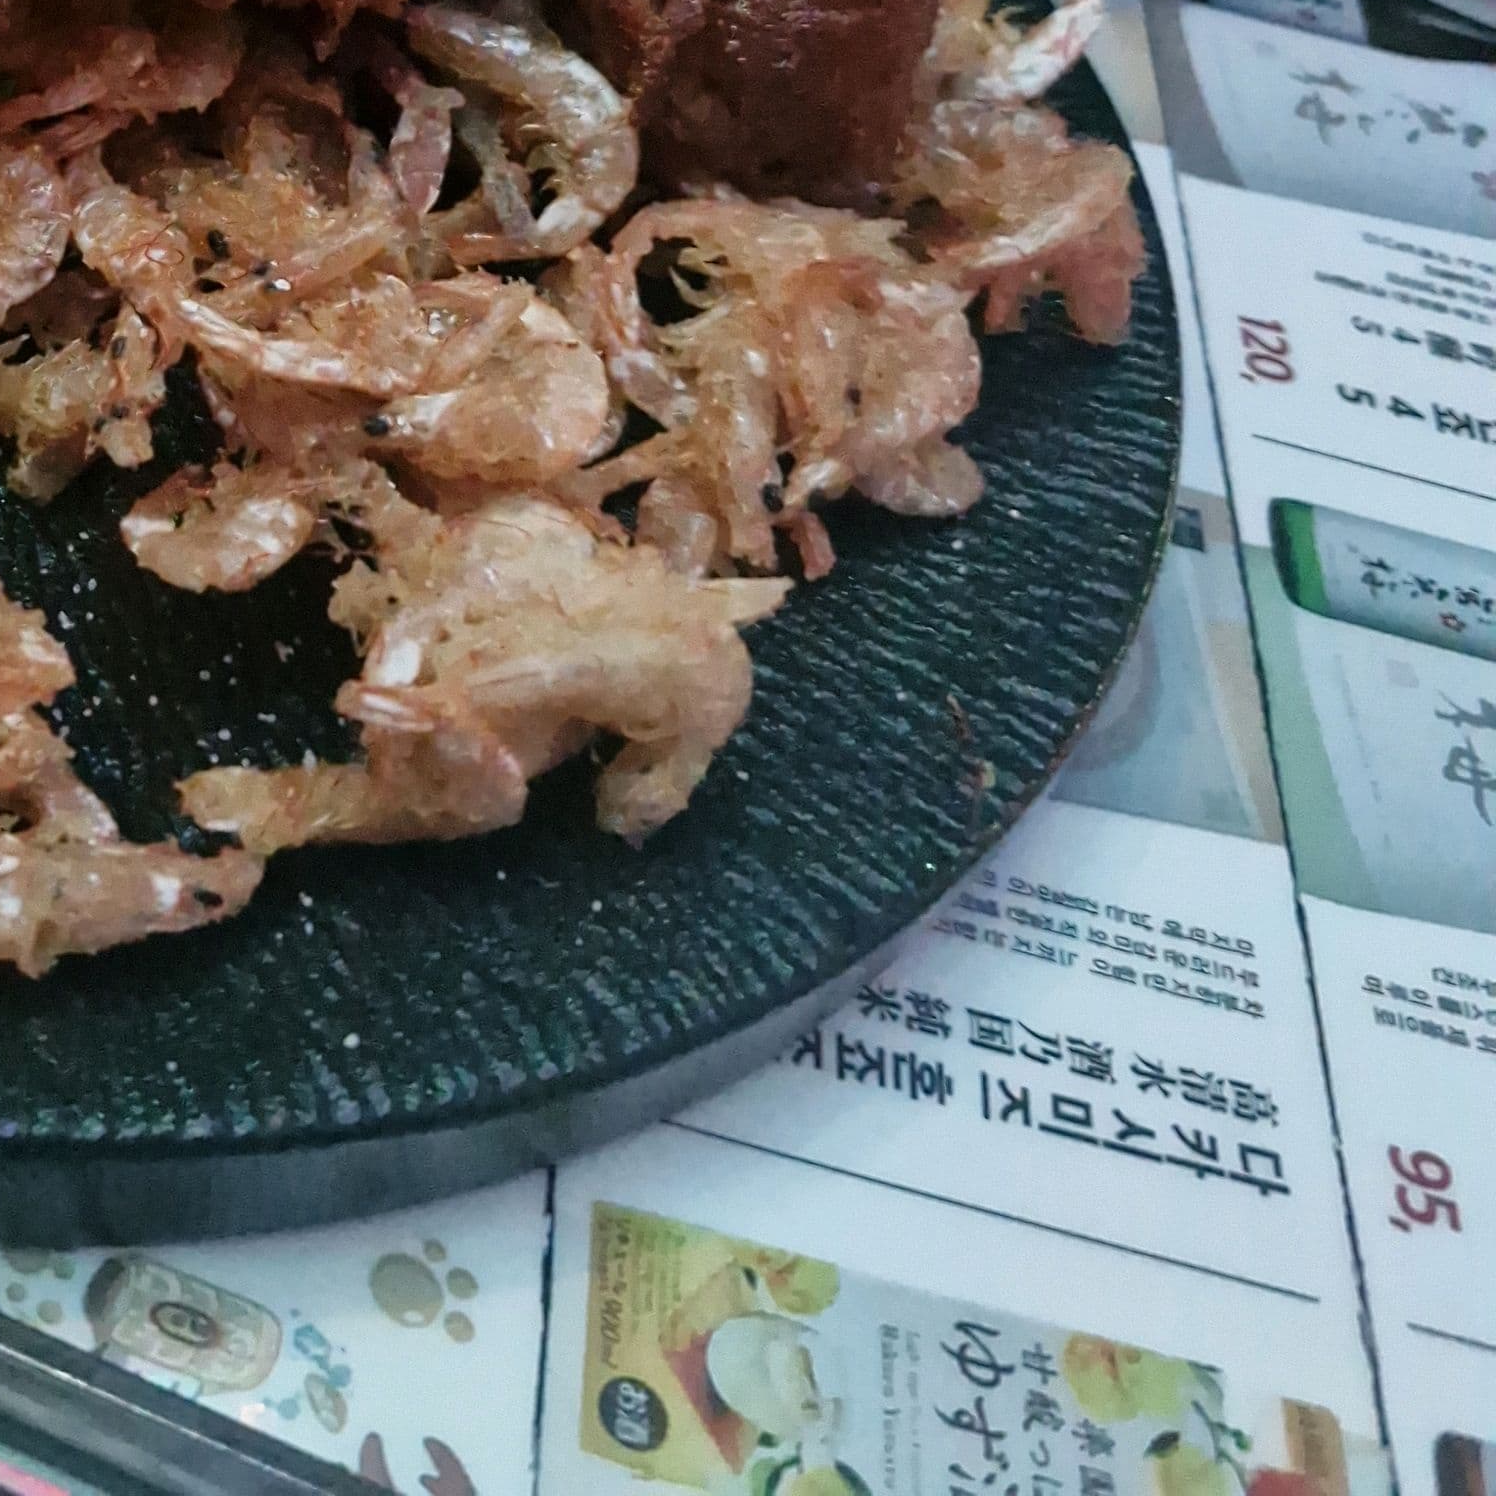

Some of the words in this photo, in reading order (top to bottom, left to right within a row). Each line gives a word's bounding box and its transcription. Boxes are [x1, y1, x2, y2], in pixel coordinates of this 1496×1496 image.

[1160, 918, 1256, 958] 마지막에
[1162, 948, 1261, 988] 부드러운
[978, 1068, 1292, 1198] 다카시미즈
